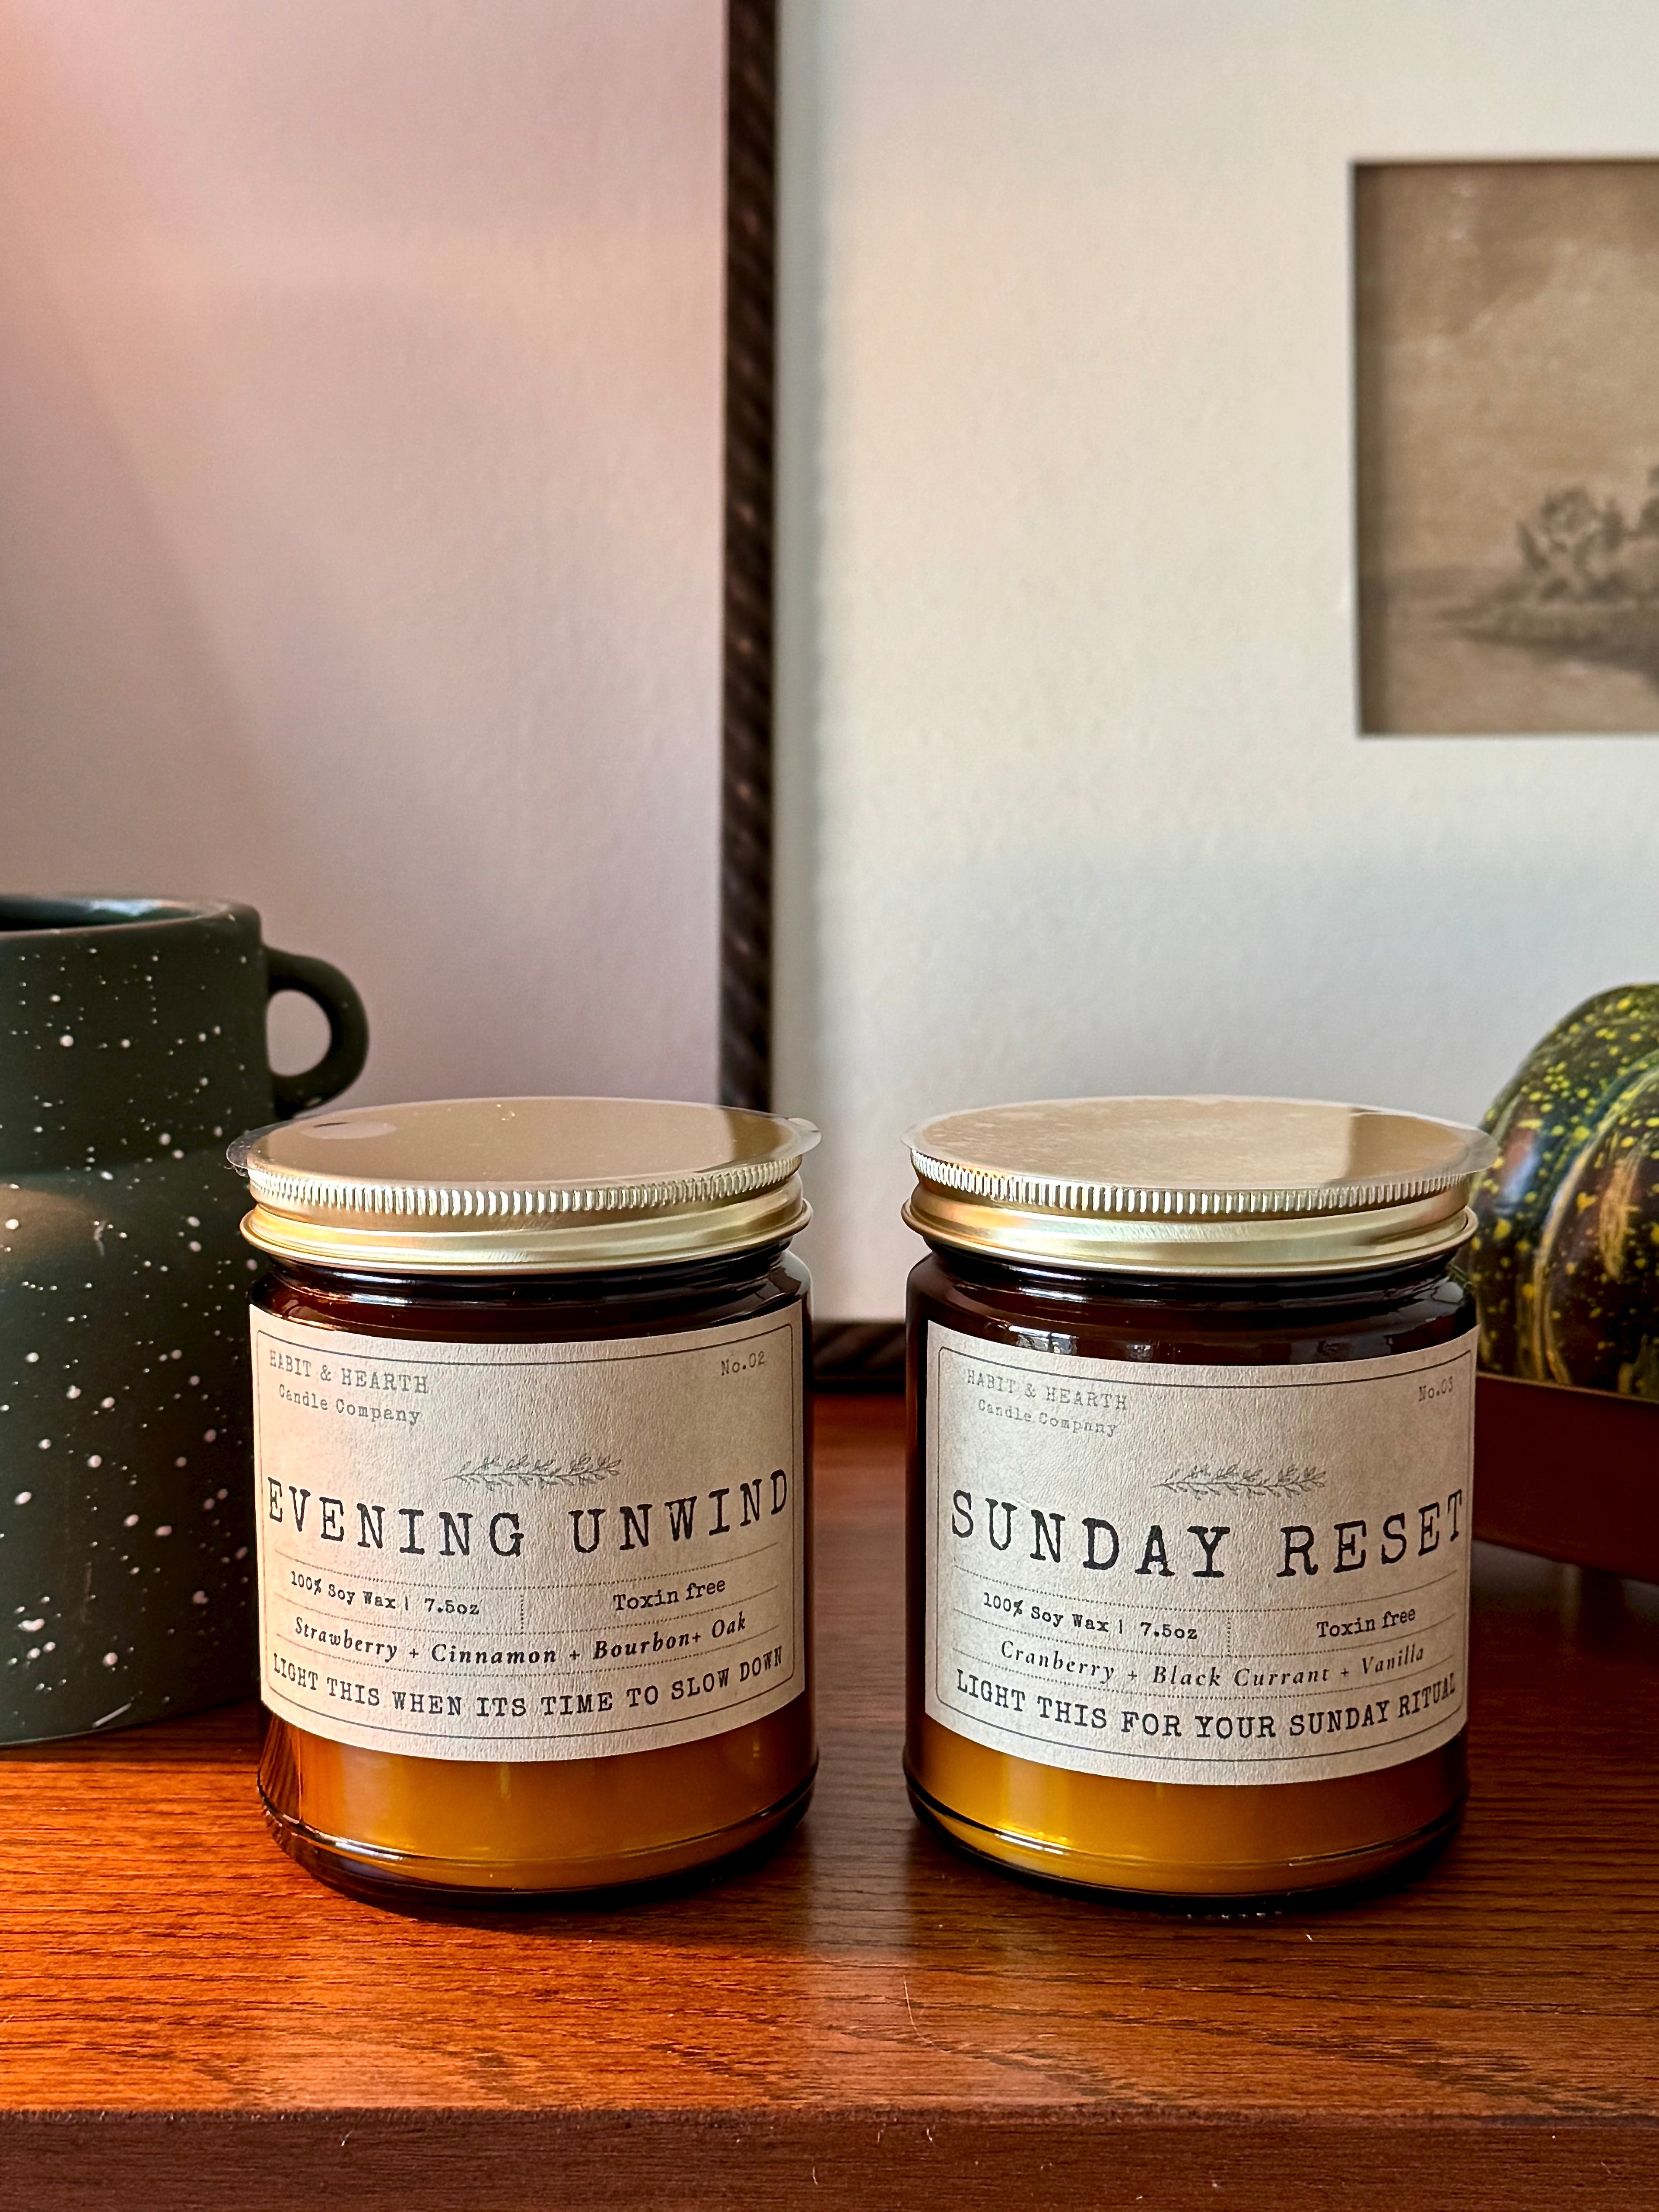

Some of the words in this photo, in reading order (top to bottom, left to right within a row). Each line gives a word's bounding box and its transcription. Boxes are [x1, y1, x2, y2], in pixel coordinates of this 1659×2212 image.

[270, 1350, 311, 1377] HABIT
[320, 1365, 331, 1382] &
[341, 1367, 429, 1394] HEARTH
[721, 1351, 765, 1376] No.02
[279, 1384, 328, 1410] Candle
[336, 1398, 421, 1425] Company
[967, 1369, 1016, 1394] HABIT
[1024, 1383, 1036, 1398] &
[1046, 1386, 1127, 1411] HEARTH
[1419, 1376, 1453, 1402] No.03
[978, 1399, 1032, 1422] Candle
[1039, 1412, 1117, 1437] Company
[268, 1477, 524, 1557] EVENING
[569, 1469, 787, 1554] UNWIND
[952, 1489, 1230, 1577] SUNDAY
[1276, 1489, 1462, 1577] RESET
[291, 1571, 321, 1595] 100%
[328, 1584, 355, 1605] Soy
[362, 1591, 396, 1609] Wax
[425, 1598, 480, 1615] 7.5oz
[613, 1589, 679, 1611] Toxin
[686, 1579, 725, 1600] free
[296, 1617, 397, 1663] Strawberry
[409, 1649, 419, 1658] +
[432, 1643, 556, 1664] Cinnamon
[569, 1650, 580, 1660] +
[712, 1611, 746, 1638] Oak
[983, 1592, 1023, 1617] 100%
[1031, 1606, 1064, 1628] Soy
[1071, 1613, 1109, 1633] Wax
[1140, 1622, 1197, 1640] 7.5oz
[1317, 1617, 1376, 1638] Toxin
[1382, 1608, 1416, 1628] free
[273, 1653, 318, 1690] LIGHT
[327, 1677, 380, 1706] THIS
[392, 1691, 462, 1716] WHEN
[476, 1697, 526, 1717] ITS
[541, 1692, 613, 1716] TIME
[626, 1686, 658, 1707] TO
[671, 1669, 729, 1700] SLOW
[739, 1646, 782, 1682] DOWN
[1001, 1640, 1114, 1684] Cranberry
[1128, 1670, 1138, 1681] +
[1153, 1665, 1220, 1686] Black
[1234, 1668, 1330, 1686] Currant
[1341, 1668, 1349, 1678] +
[1362, 1643, 1424, 1674] Vanilla
[957, 1669, 1025, 1712] LIGHT
[1037, 1695, 1106, 1729] THIS
[1121, 1711, 1181, 1737] FOR
[1195, 1716, 1275, 1739] YOUR
[1289, 1700, 1389, 1737] SUNDAY
[1398, 1672, 1456, 1718] RITUAL
